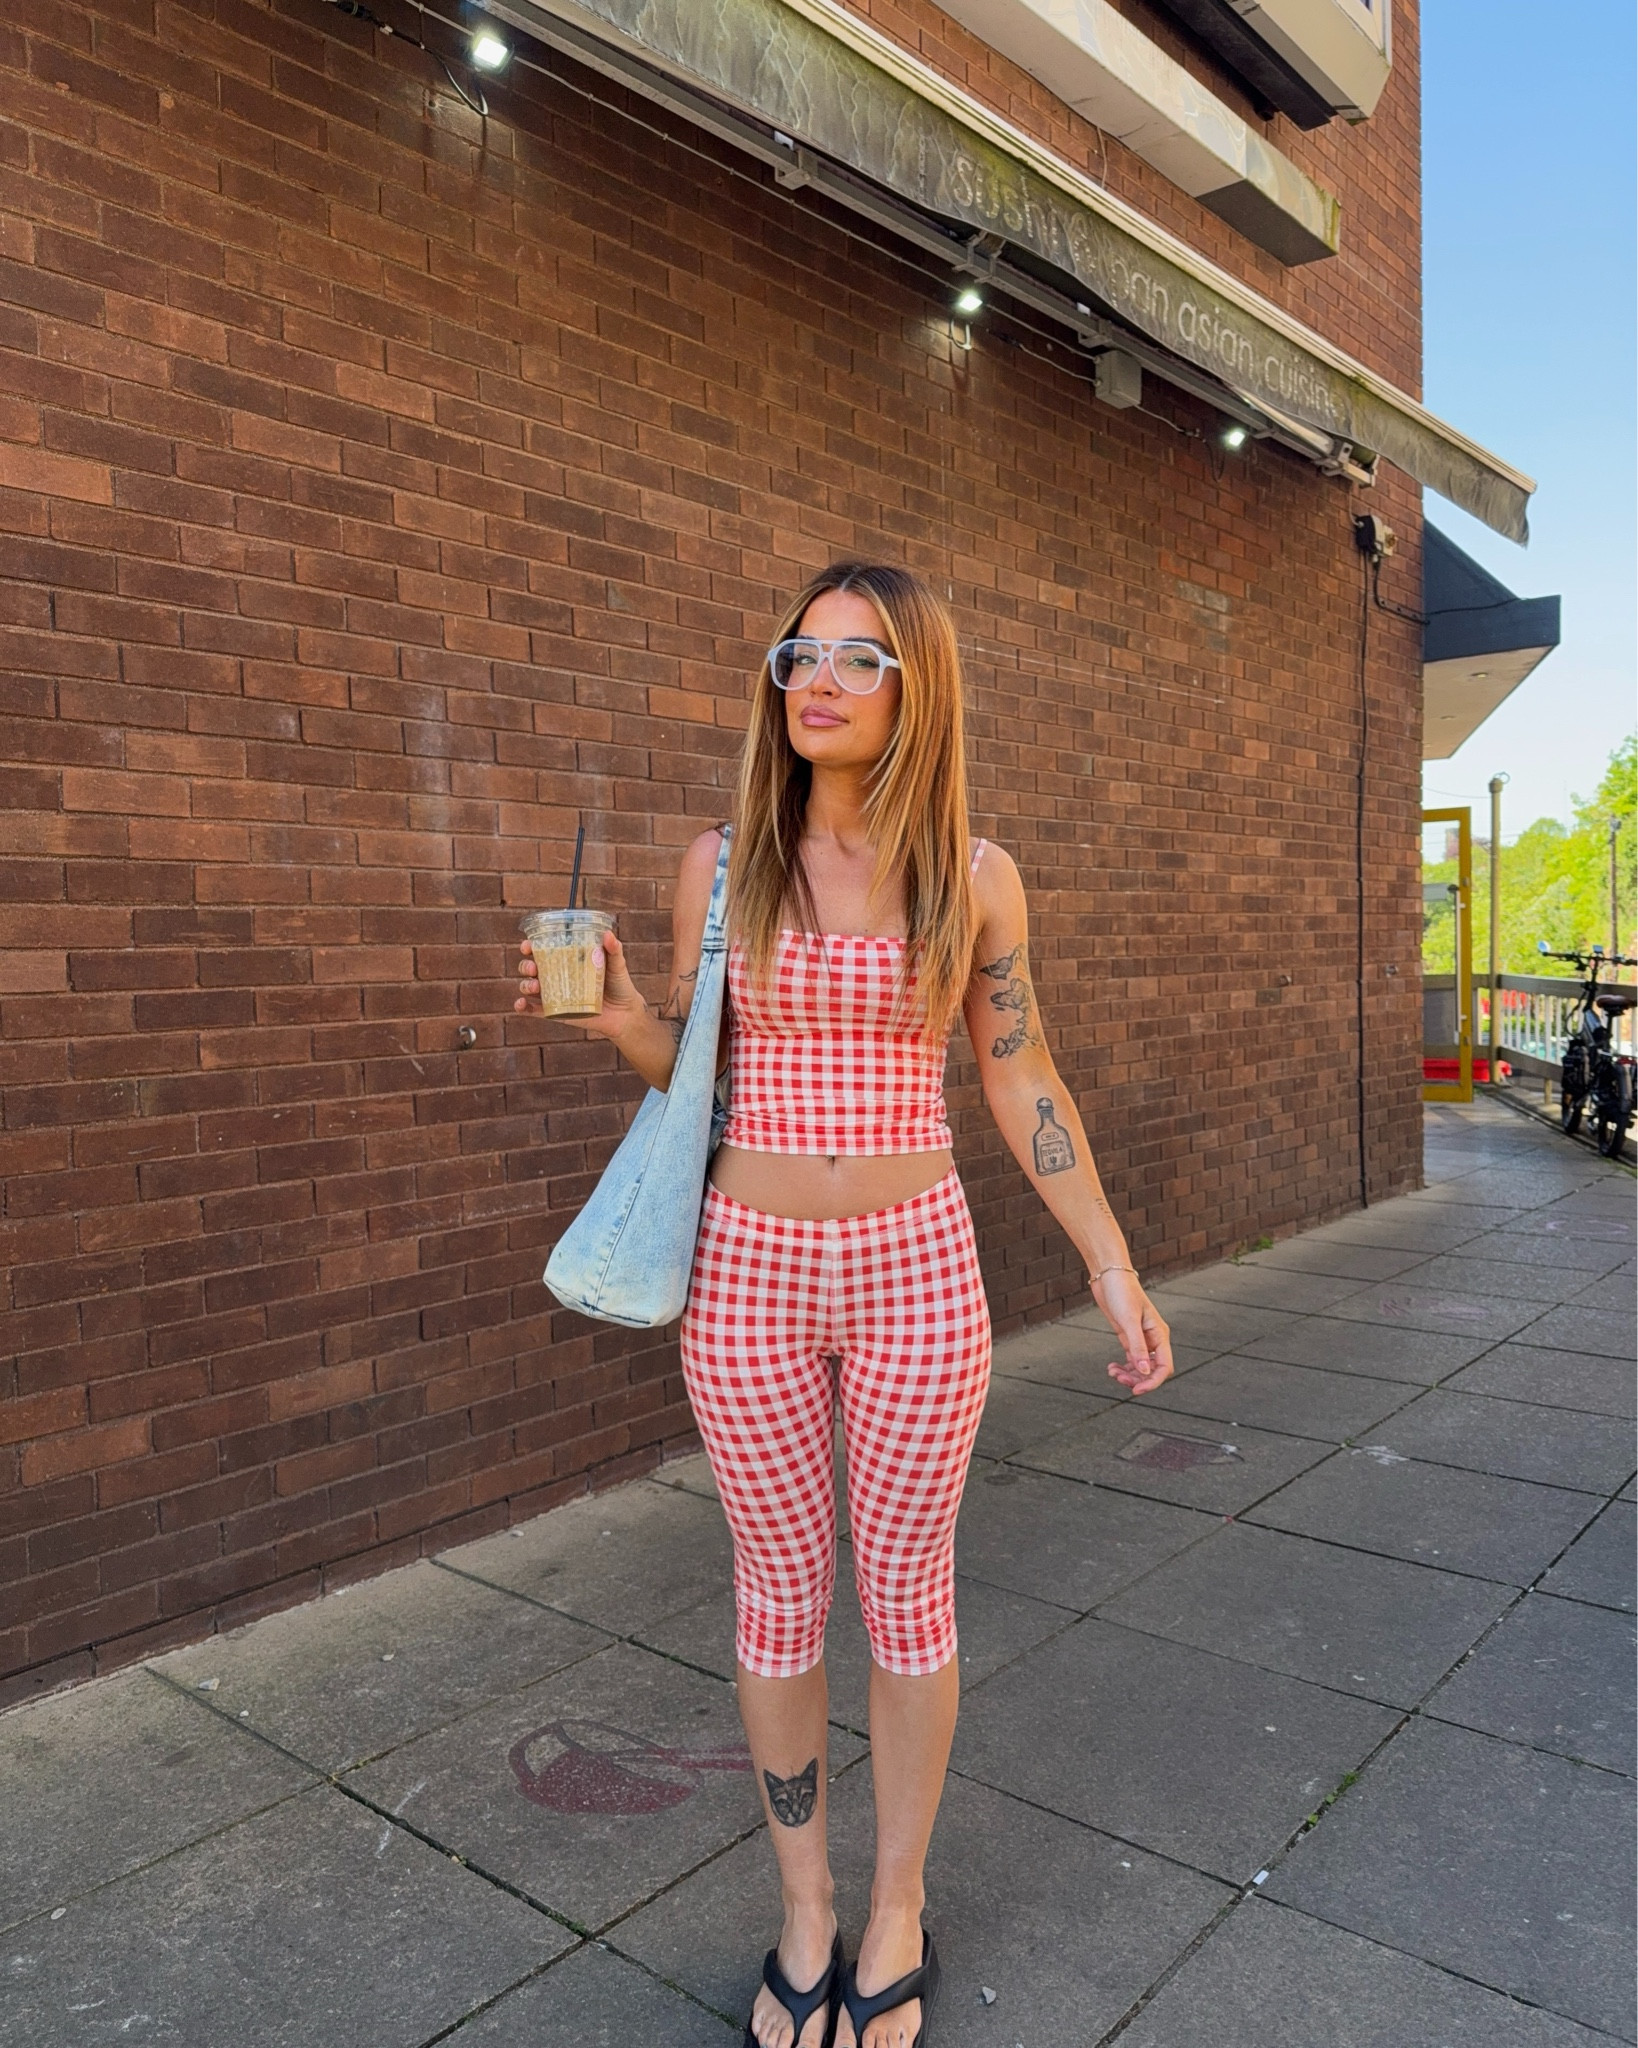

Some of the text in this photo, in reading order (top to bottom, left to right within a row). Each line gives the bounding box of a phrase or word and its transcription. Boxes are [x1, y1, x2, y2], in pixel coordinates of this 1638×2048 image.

[953, 155, 1059, 247] sushi
[1110, 255, 1169, 327] pan
[1178, 302, 1254, 379] asian
